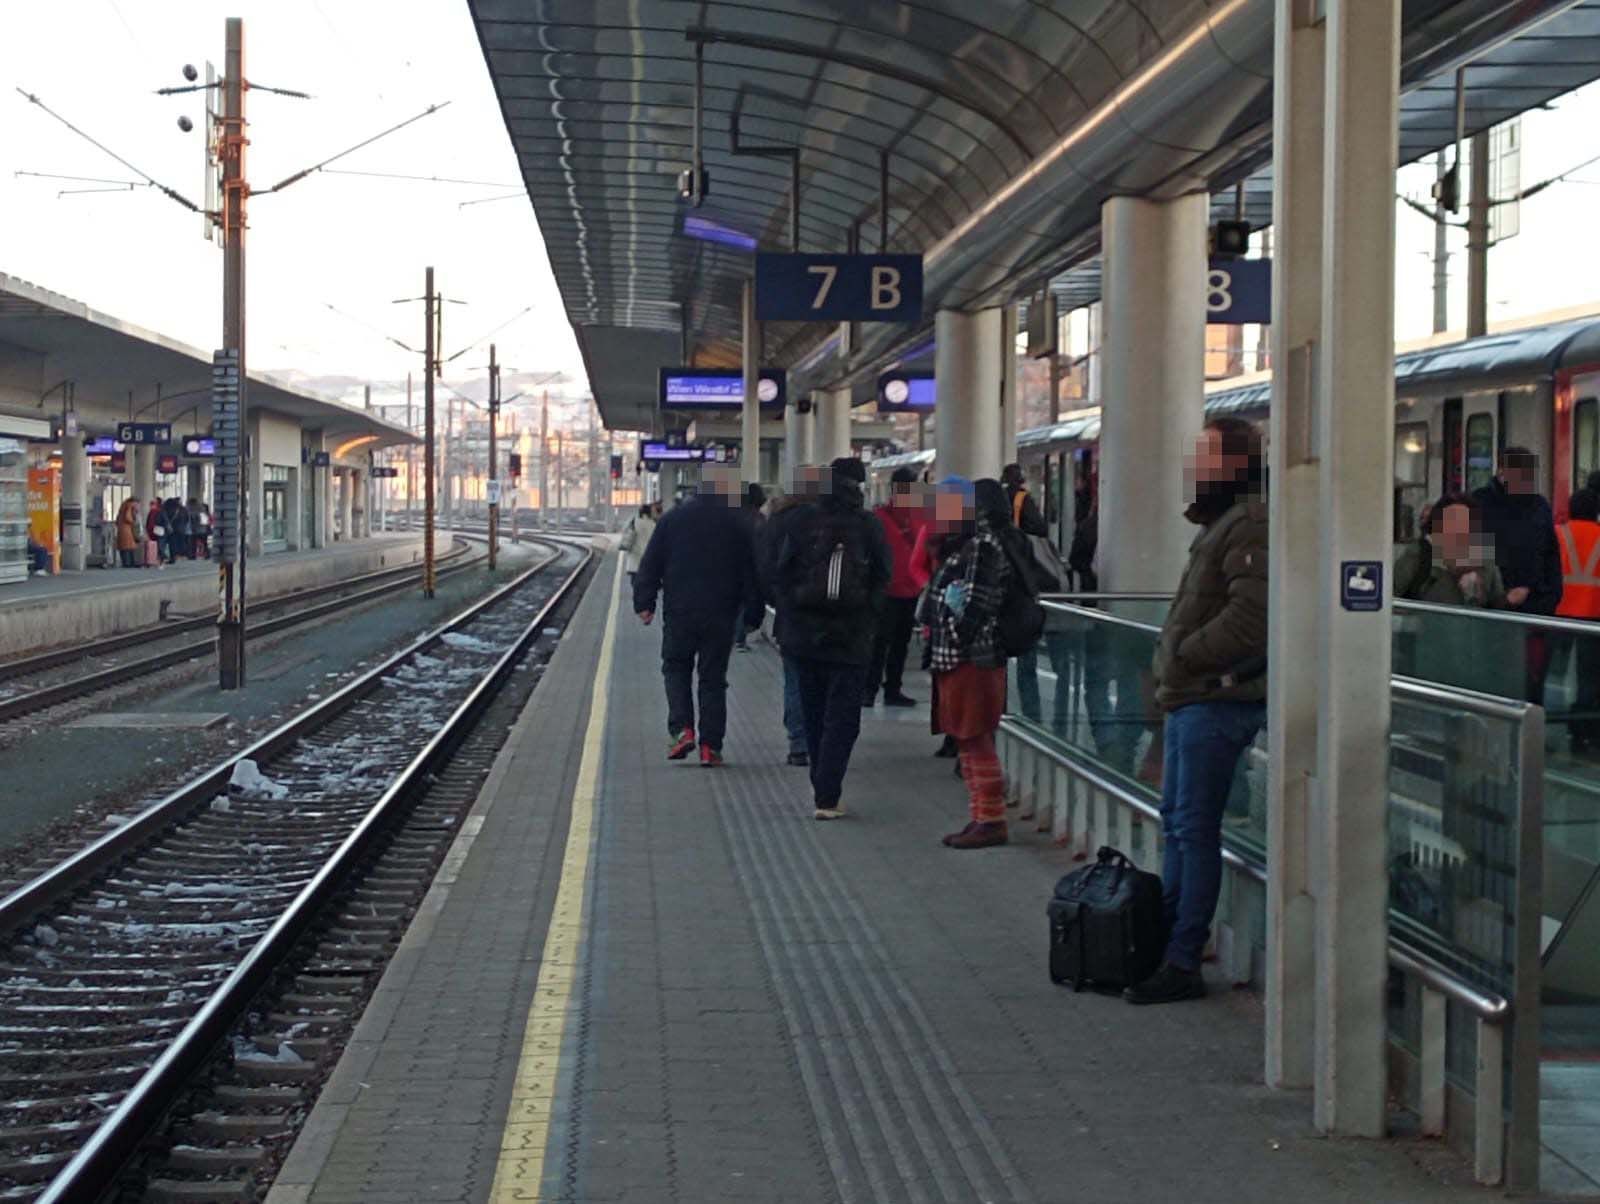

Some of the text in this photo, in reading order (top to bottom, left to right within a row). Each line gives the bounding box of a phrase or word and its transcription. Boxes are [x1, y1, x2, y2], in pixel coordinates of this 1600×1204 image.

[807, 265, 901, 310] 7 B
[1206, 269, 1233, 312] 8
[121, 426, 132, 441] 6
